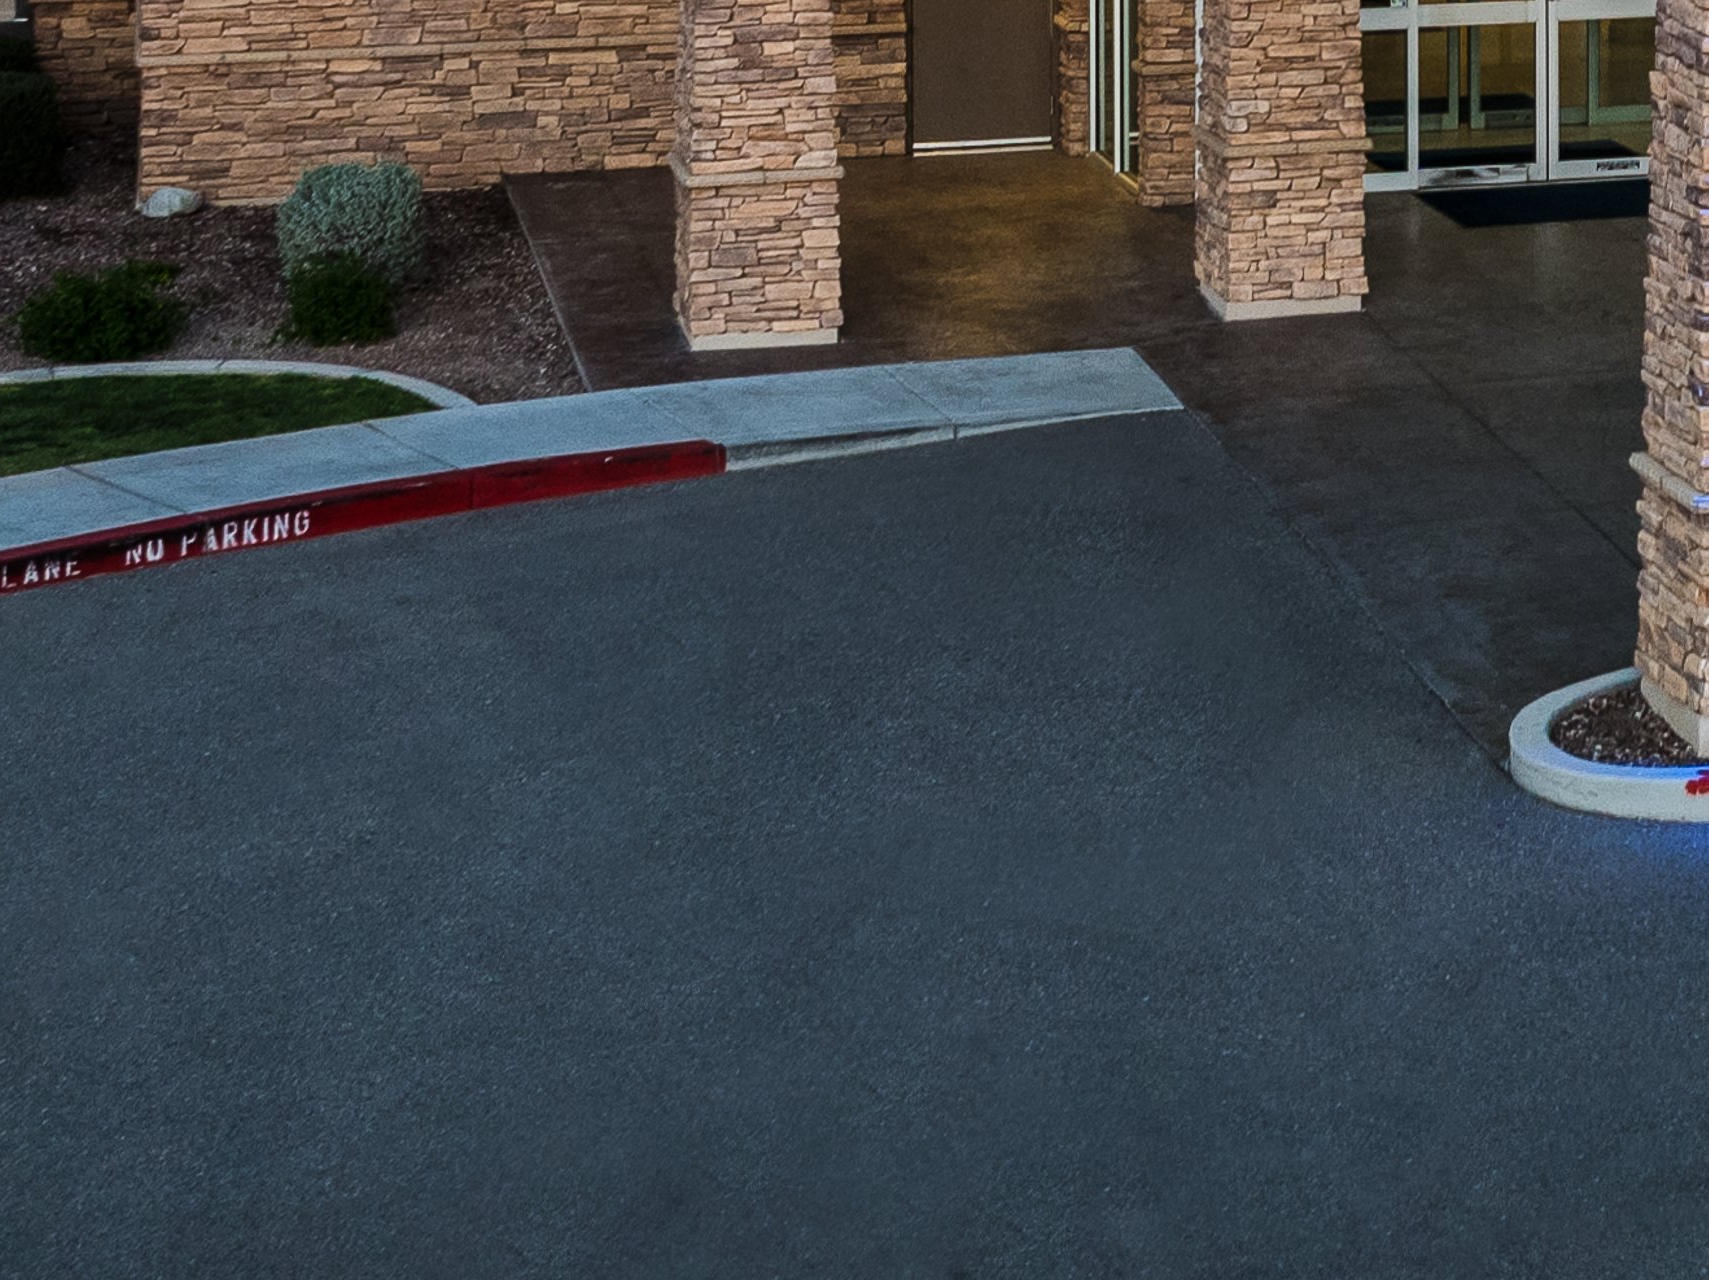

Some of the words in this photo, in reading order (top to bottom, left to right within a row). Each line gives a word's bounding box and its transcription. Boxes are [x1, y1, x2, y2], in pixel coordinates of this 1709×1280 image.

[1, 559, 81, 588] LANE
[125, 538, 164, 566] NO
[181, 510, 311, 557] PARKING
